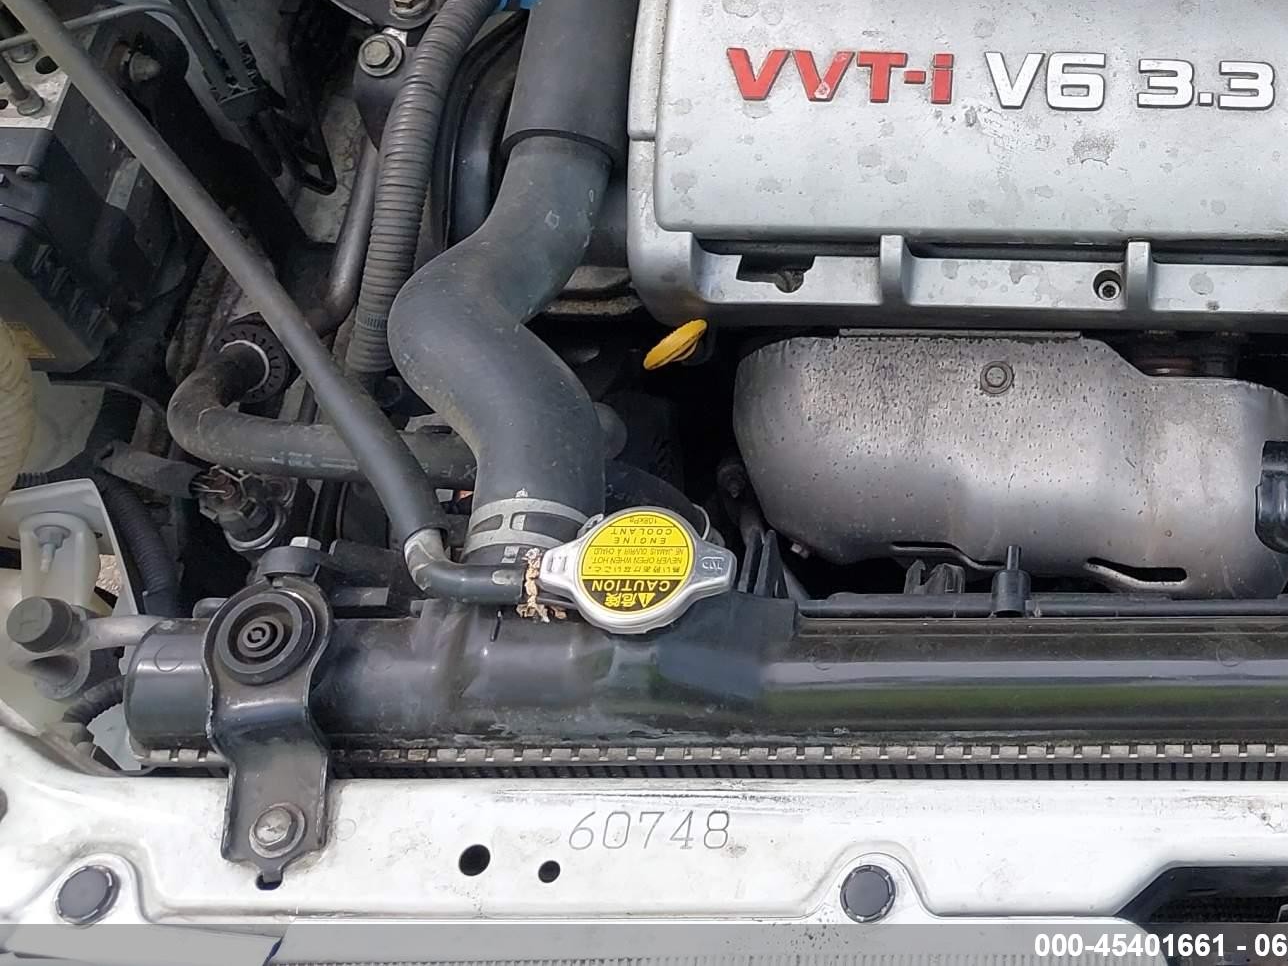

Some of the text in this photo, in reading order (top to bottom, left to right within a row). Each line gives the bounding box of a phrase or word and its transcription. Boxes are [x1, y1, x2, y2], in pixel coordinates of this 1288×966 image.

[726, 47, 1276, 111] VVT-i V6 3.3
[611, 528, 673, 536] COOLANT
[611, 556, 632, 564] WHEN
[634, 556, 655, 564] OPEN
[657, 556, 682, 564] NEVER
[592, 580, 671, 592] CAUTION
[604, 592, 637, 608] 危険
[568, 810, 730, 850] 60748
